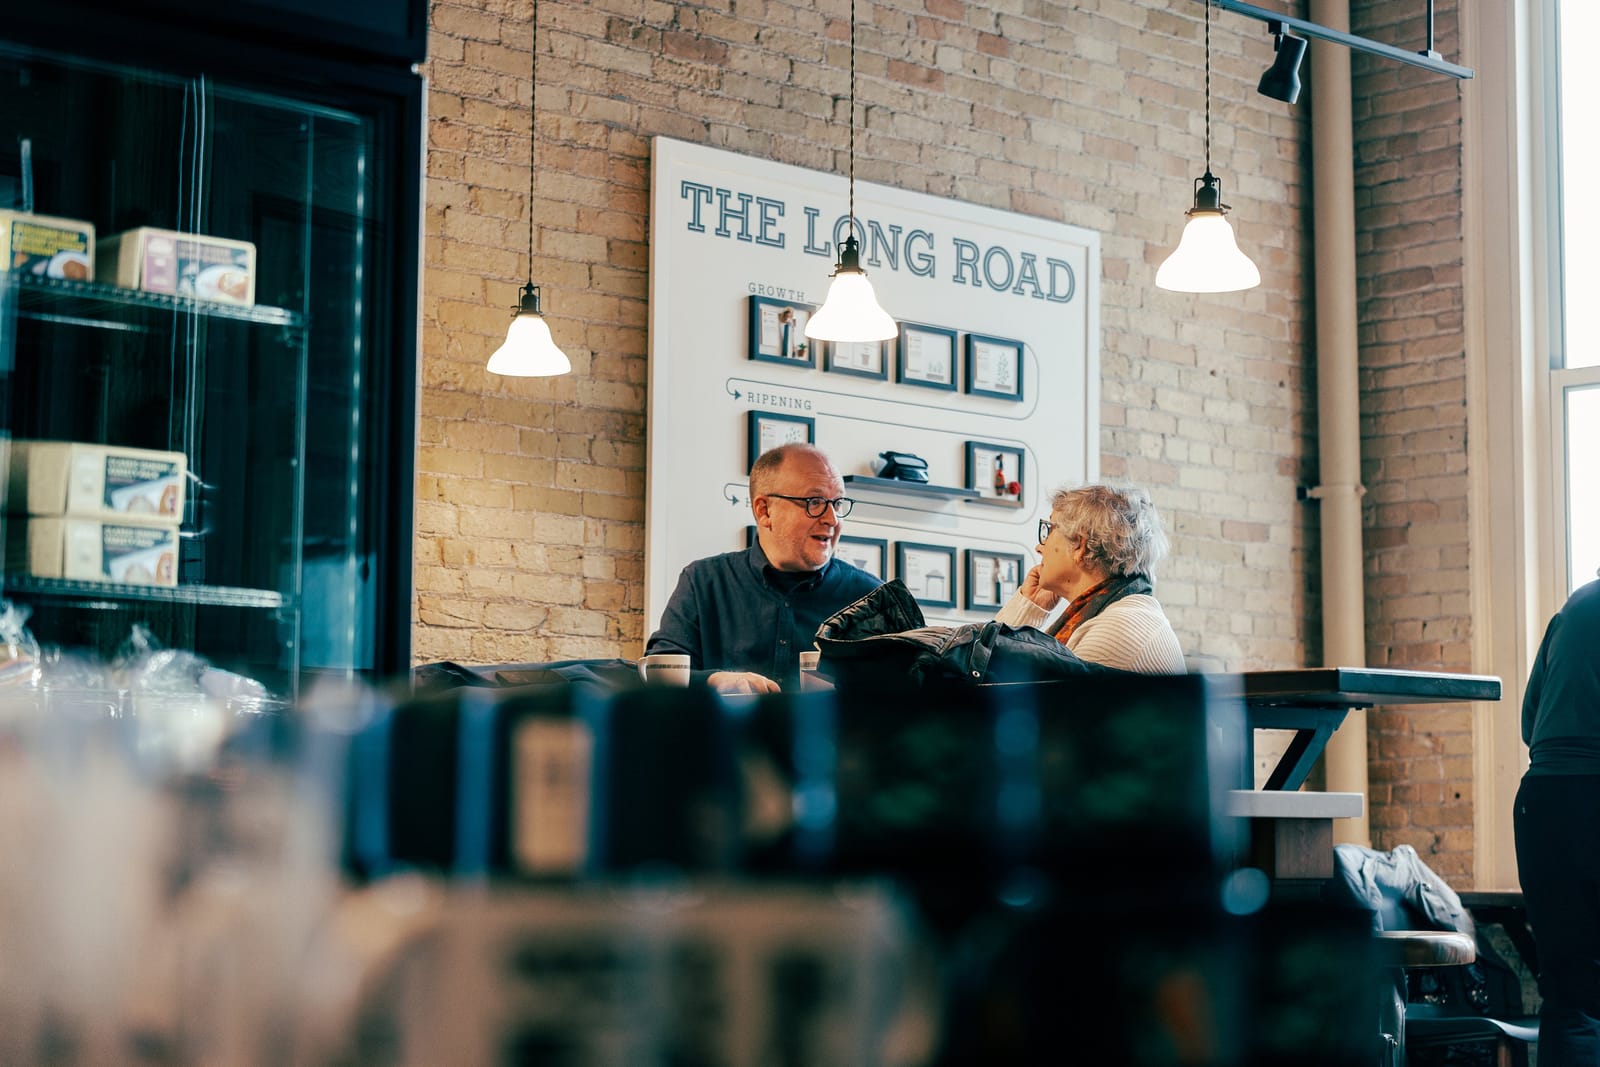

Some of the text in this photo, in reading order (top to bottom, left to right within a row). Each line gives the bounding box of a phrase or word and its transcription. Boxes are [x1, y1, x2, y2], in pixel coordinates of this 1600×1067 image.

[681, 180, 1076, 304] THE LONG ROAD
[747, 282, 806, 301] GROWTH
[747, 391, 812, 410] RIPENING
